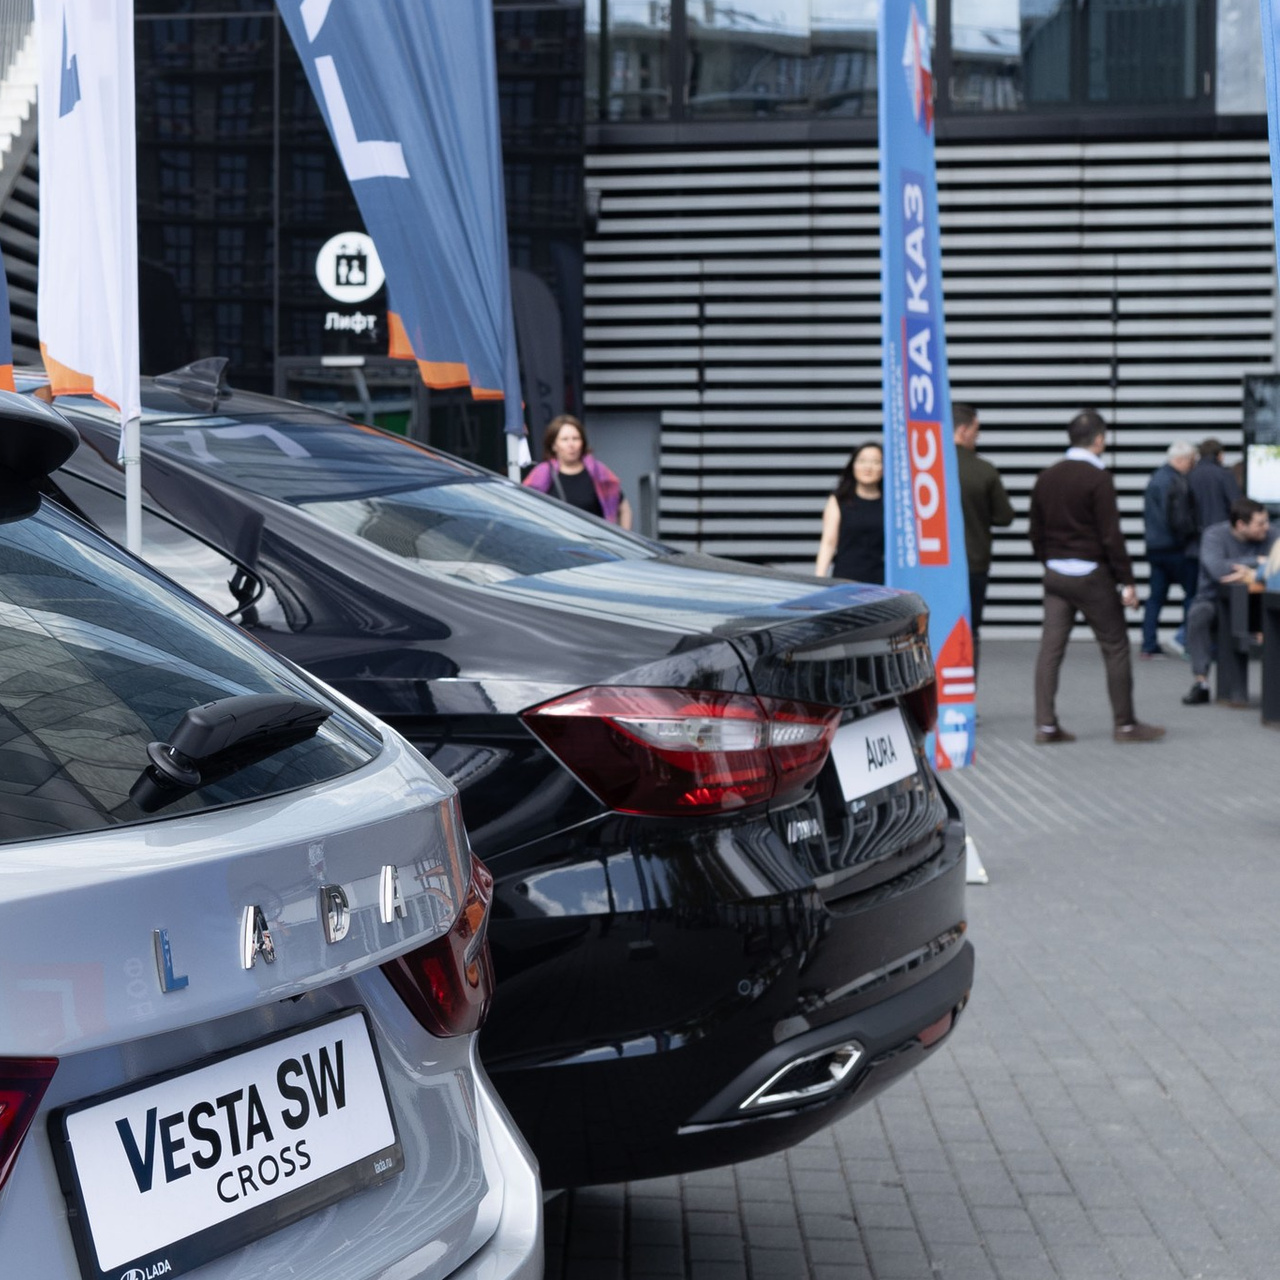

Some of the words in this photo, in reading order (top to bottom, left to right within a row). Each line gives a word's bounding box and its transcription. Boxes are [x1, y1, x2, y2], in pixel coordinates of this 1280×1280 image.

[324, 312, 377, 334] Лифт
[912, 427, 941, 553] ГОС
[865, 735, 898, 772] AURA
[153, 864, 408, 993] LADA
[115, 1084, 274, 1194] VESTA
[276, 1039, 347, 1131] SW
[216, 1140, 312, 1204] CROSS
[373, 1157, 393, 1174] lada.ru
[145, 1259, 172, 1280] LADA
